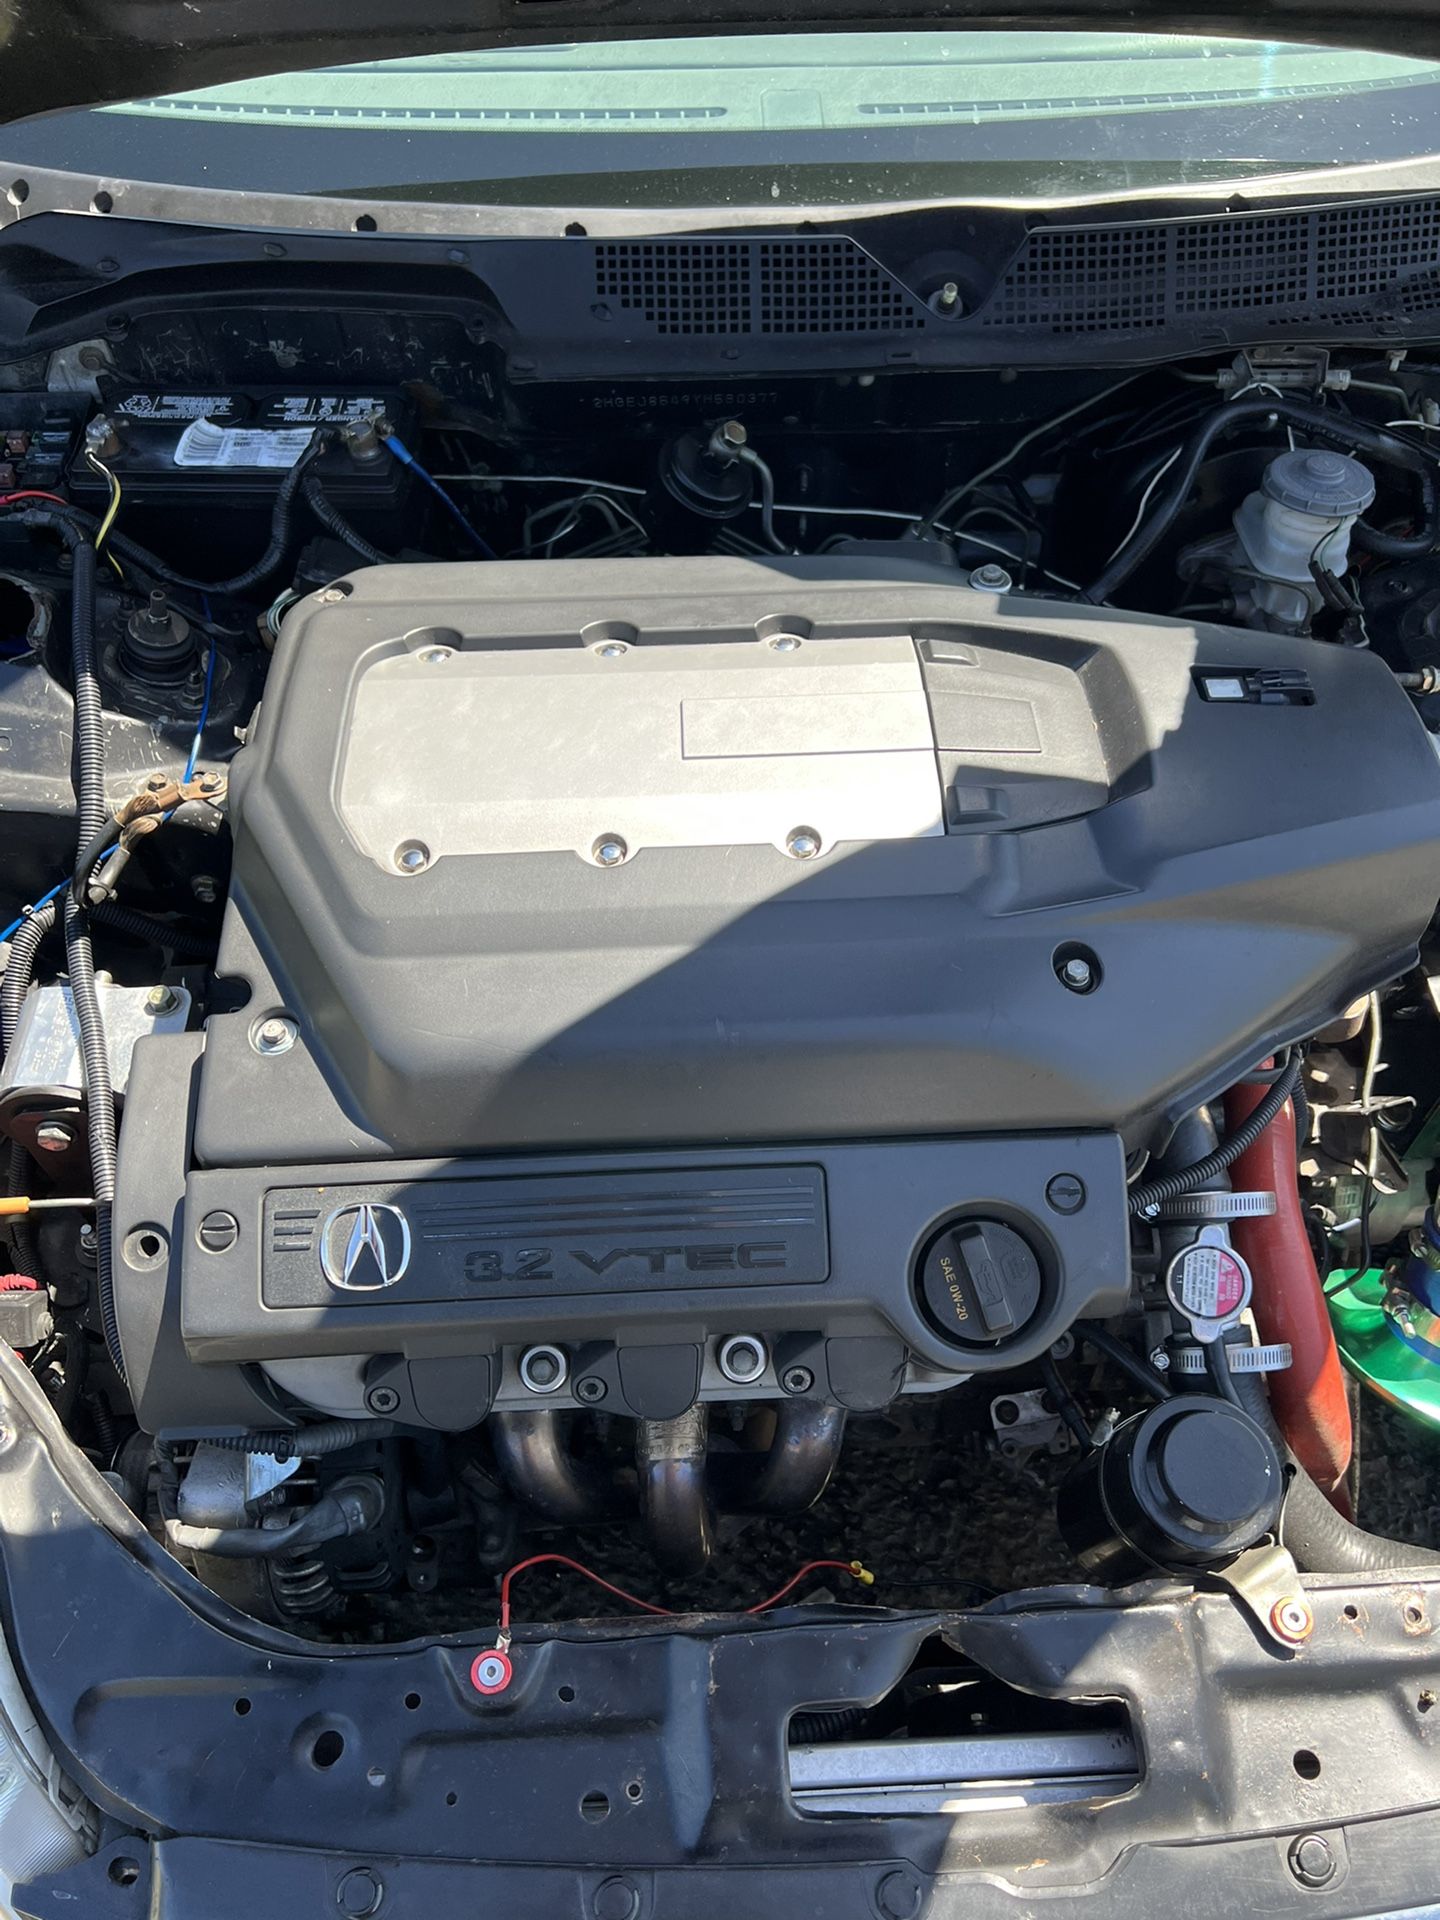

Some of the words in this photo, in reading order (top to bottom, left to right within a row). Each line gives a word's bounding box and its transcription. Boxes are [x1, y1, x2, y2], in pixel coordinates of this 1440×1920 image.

[463, 1248, 554, 1282] 3.2
[568, 1240, 788, 1275] VTEC
[940, 1256, 957, 1283] SAE
[948, 1283, 969, 1321] 0W-20
